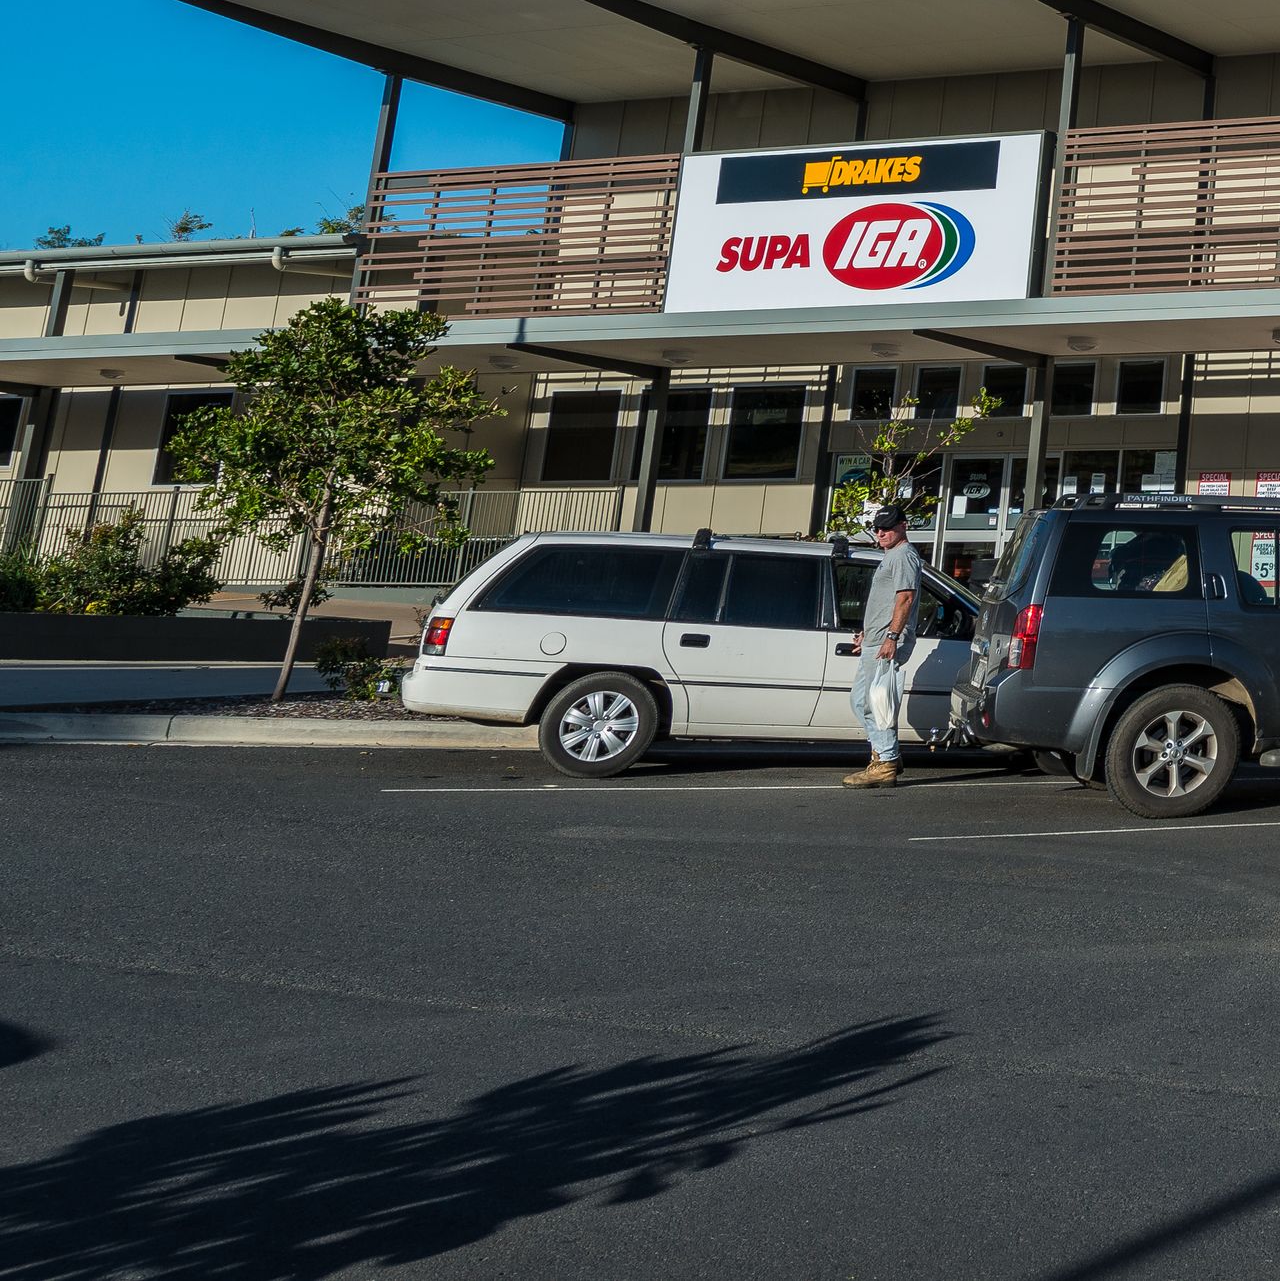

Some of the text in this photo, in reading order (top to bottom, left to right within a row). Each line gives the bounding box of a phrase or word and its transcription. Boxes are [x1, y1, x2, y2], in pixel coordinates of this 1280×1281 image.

[829, 156, 923, 186] DRAKES
[715, 218, 931, 272] SUPA IGA
[970, 473, 987, 481] SUPA
[1201, 473, 1228, 482] SPECIAL
[1127, 495, 1193, 503] PATHFINDER
